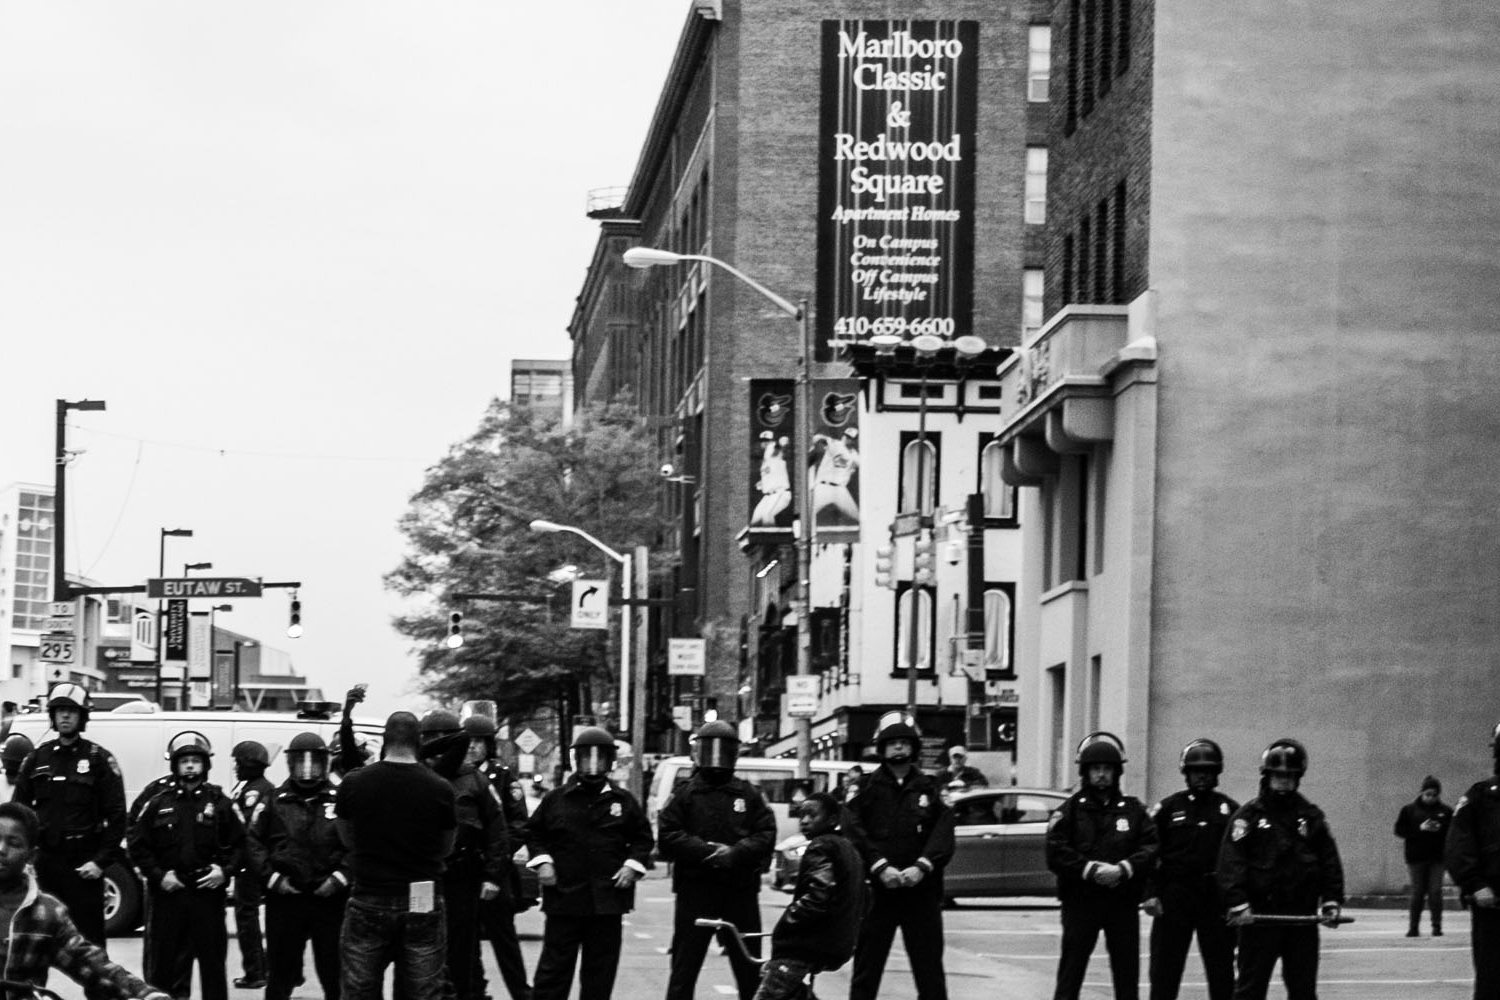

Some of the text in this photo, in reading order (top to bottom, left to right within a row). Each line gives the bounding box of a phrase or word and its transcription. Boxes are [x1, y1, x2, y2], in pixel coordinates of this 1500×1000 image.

[837, 30, 963, 59] Marlboro
[853, 62, 947, 91] Classic
[886, 100, 911, 128] &
[833, 132, 962, 162] Redwood
[850, 166, 944, 203] Square
[831, 204, 961, 225] Apartment Homes
[852, 234, 939, 252] On Campus
[850, 252, 942, 267] Convenience
[851, 268, 939, 287] Off Campus
[862, 286, 928, 305] Lifestyle
[833, 316, 955, 336] 410-659-6600
[163, 581, 247, 596] EUTAW ST.
[41, 642, 72, 659] 295
